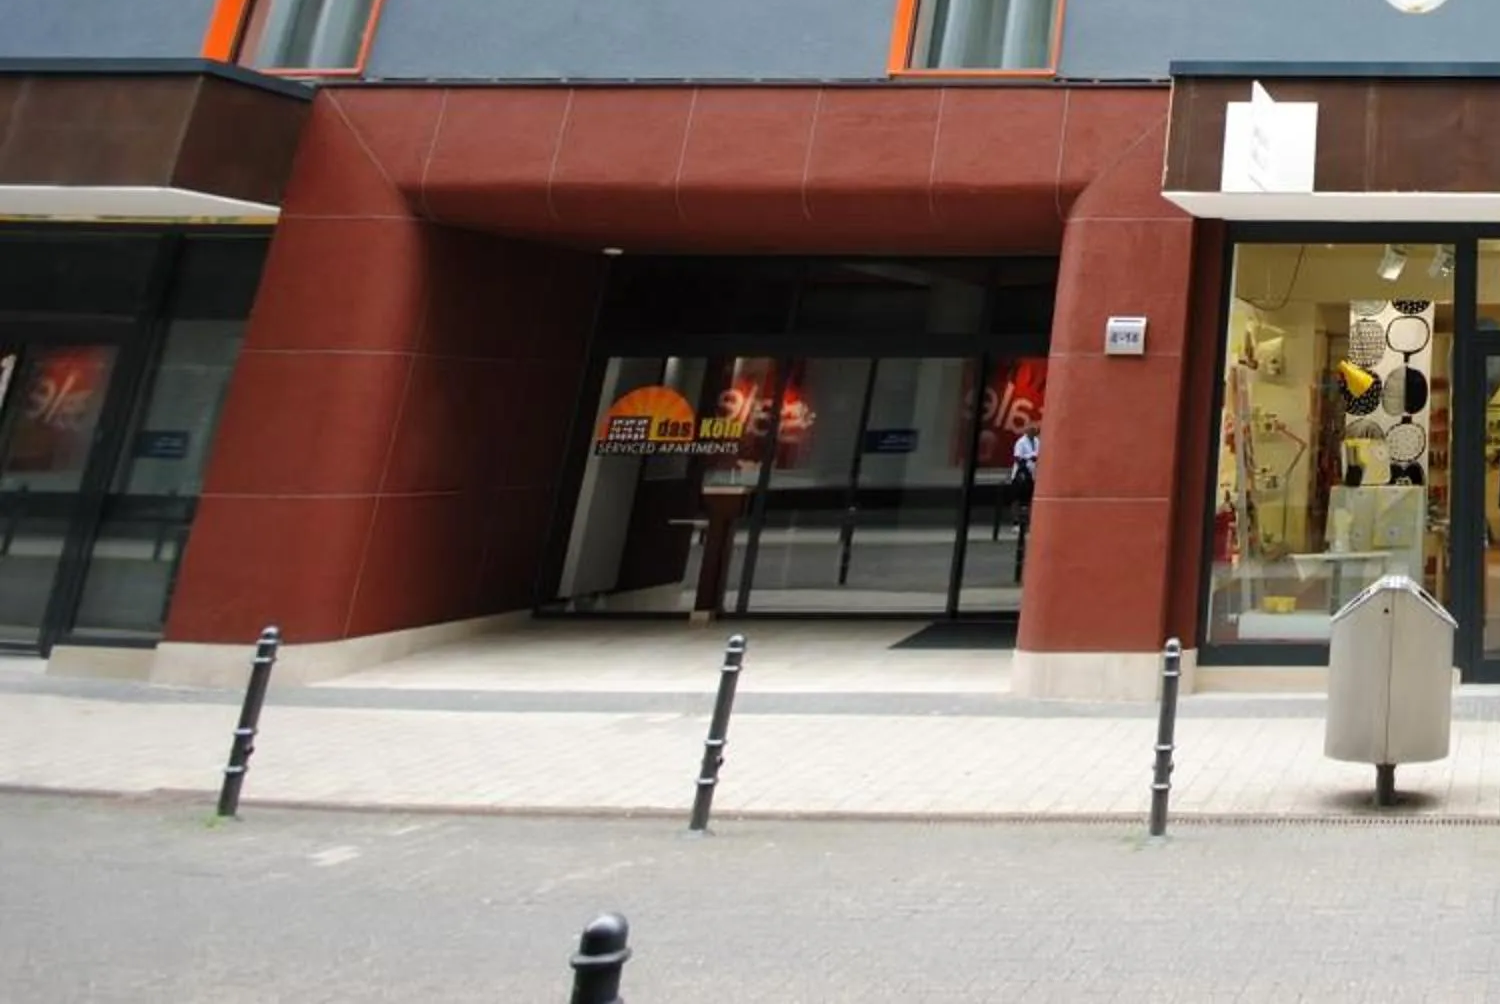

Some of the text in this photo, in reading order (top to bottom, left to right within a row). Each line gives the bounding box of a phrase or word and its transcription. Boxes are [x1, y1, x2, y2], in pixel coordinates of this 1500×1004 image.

[658, 416, 745, 439] das Köln
[598, 441, 740, 456] SERVICED APARTMENTS
